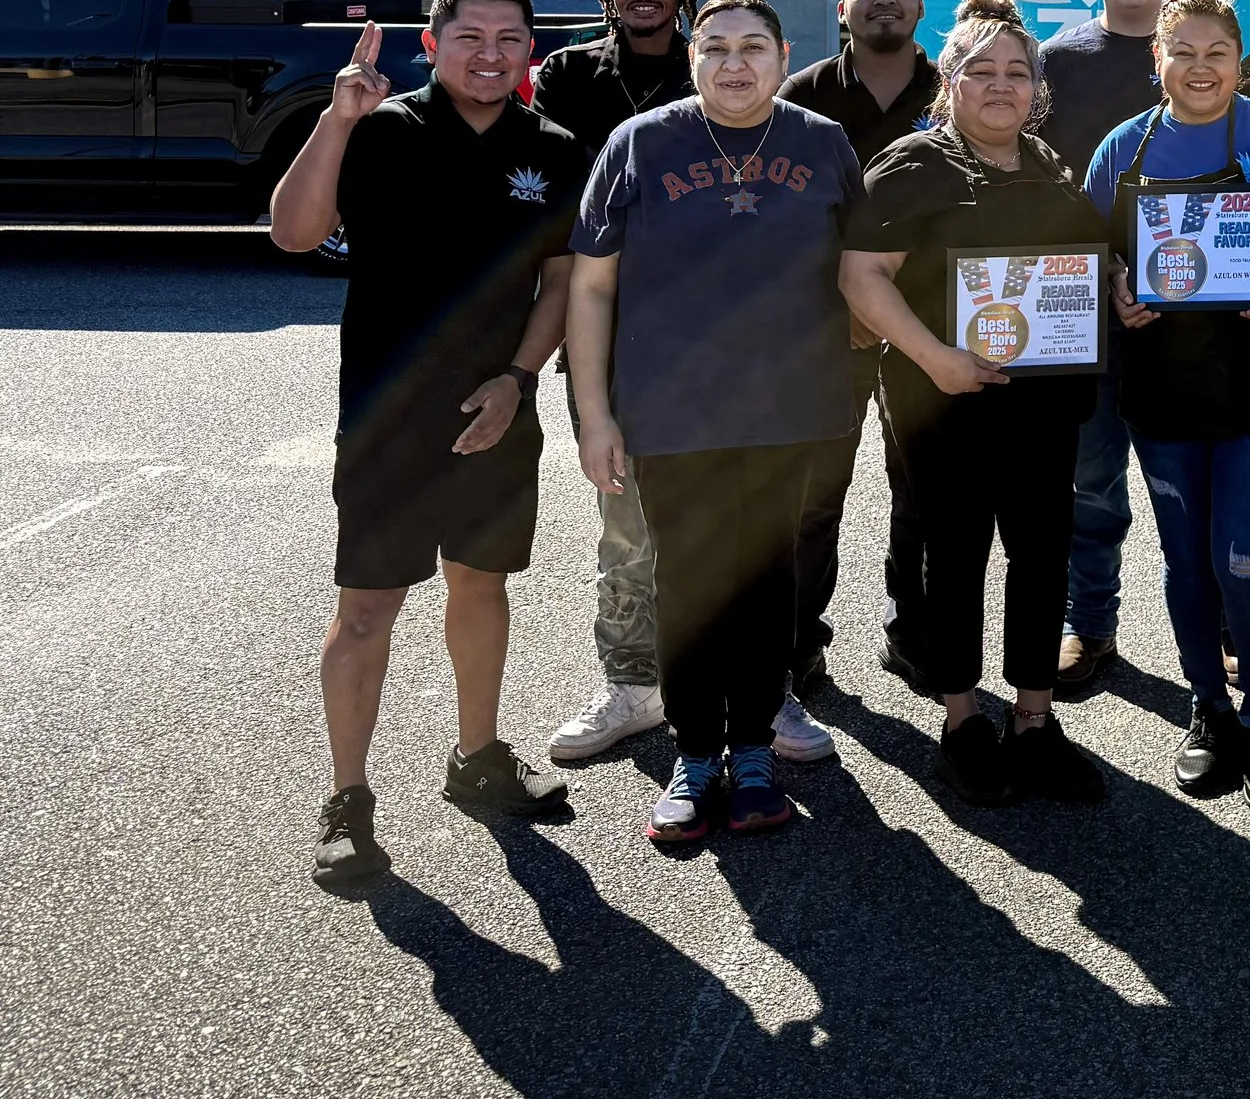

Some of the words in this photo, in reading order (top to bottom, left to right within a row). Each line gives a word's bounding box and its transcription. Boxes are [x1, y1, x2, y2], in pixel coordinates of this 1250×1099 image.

[661, 155, 813, 201] ASTROS
[509, 188, 546, 203] AZUL
[1043, 256, 1089, 275] 2025
[1157, 252, 1189, 267] Best
[1169, 268, 1196, 280] Boro
[1041, 284, 1090, 298] READER
[1167, 281, 1186, 290] 2025
[1035, 297, 1096, 312] FAVORITE
[977, 317, 1011, 333] Best
[989, 333, 1017, 346] Boro
[987, 347, 1007, 356] 2025
[1058, 346, 1089, 354] TEX-MEX
